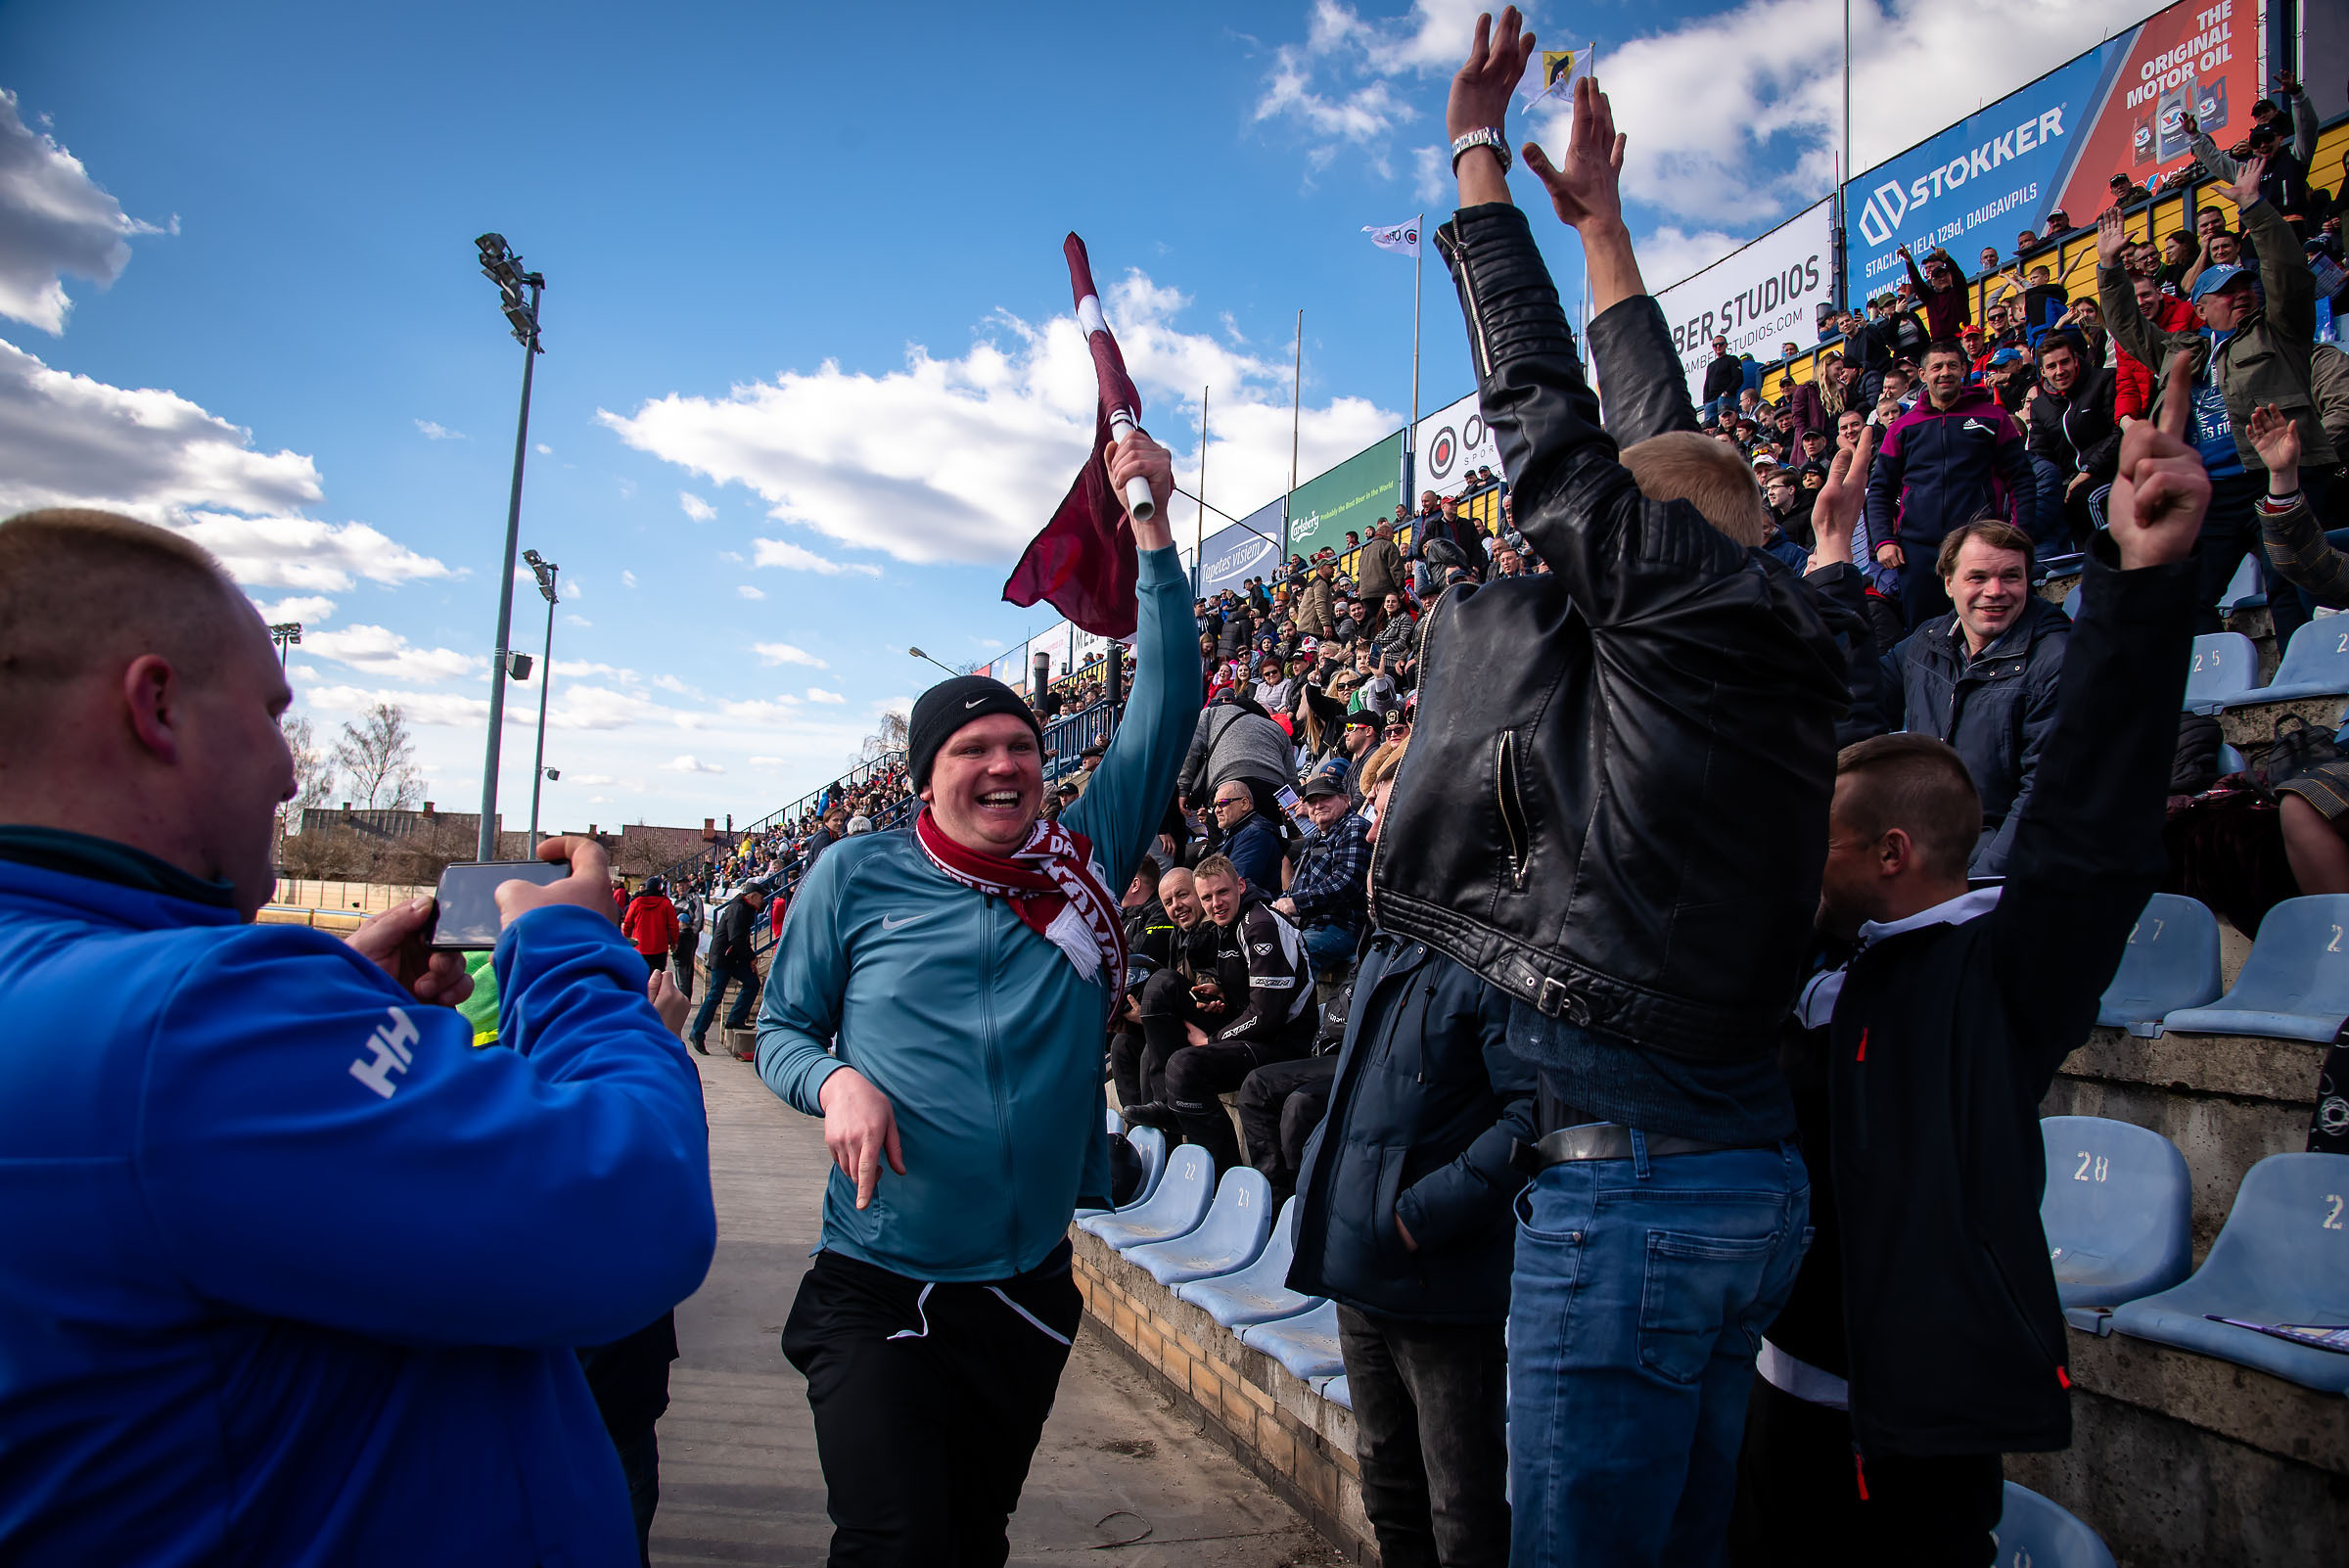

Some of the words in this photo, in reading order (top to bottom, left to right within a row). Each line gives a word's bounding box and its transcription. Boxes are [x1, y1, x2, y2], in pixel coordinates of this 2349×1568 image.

[2196, 0, 2233, 31] THE
[2141, 22, 2233, 81] ORIGINAL
[2126, 61, 2195, 110] MOTOR
[2199, 42, 2233, 72] OIL
[1909, 106, 2065, 211] STOKKER
[1913, 232, 1936, 255] IELA
[1966, 182, 2038, 230] DAUGAVPILS
[1720, 254, 1819, 335] STUDIOS
[1290, 509, 1320, 544] Carlsberg
[1202, 555, 1231, 585] Tapetes
[1232, 541, 1261, 568] visiem
[1184, 1161, 1196, 1181] 22
[2073, 1150, 2109, 1182] 28
[1237, 1186, 1251, 1208] 23
